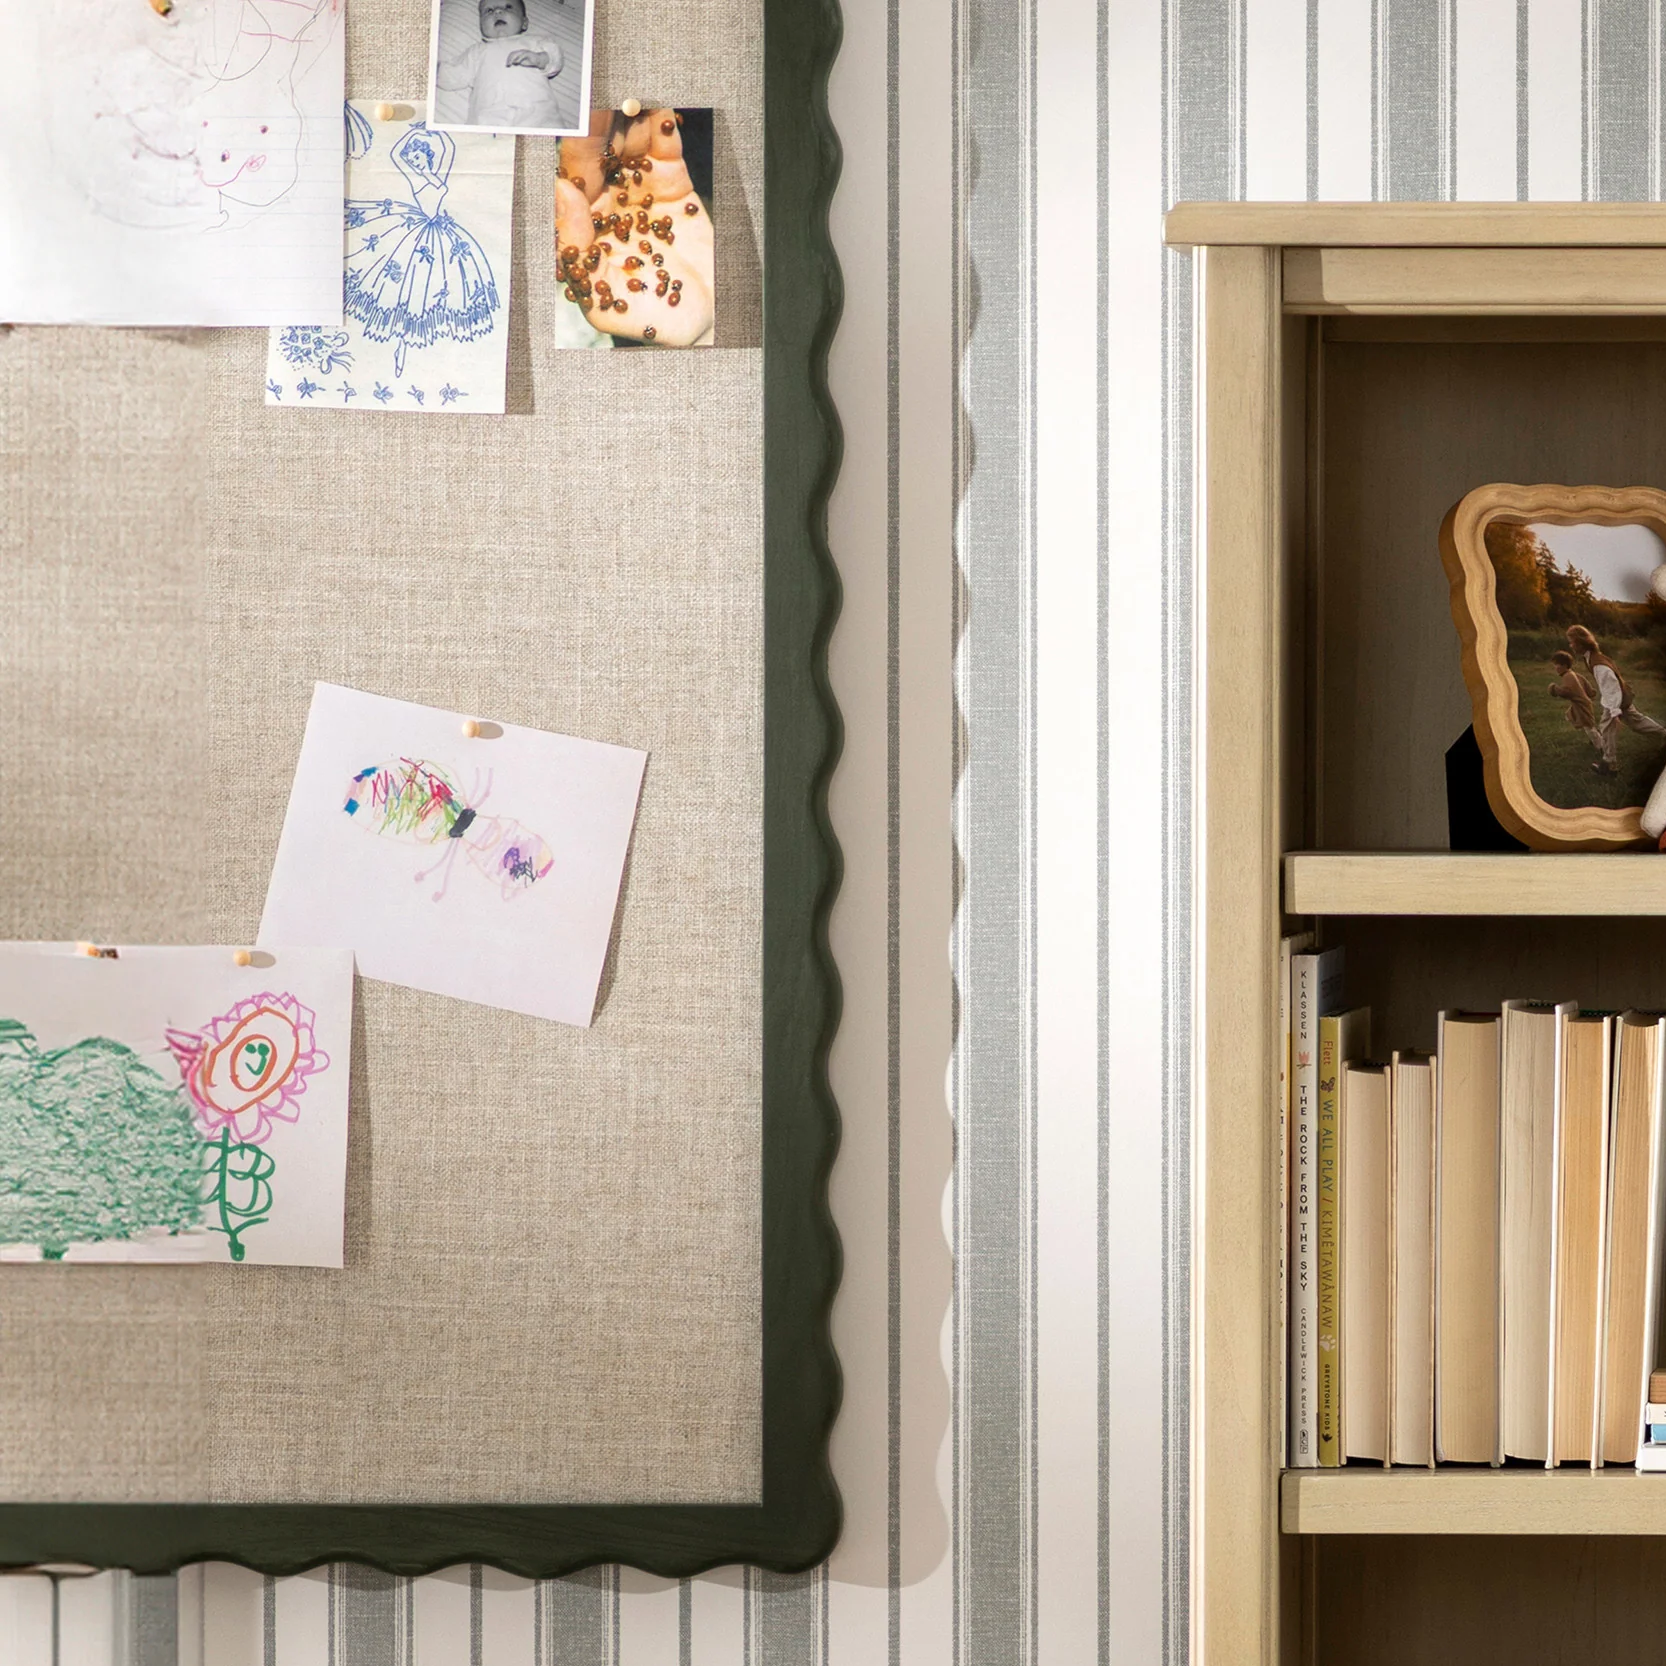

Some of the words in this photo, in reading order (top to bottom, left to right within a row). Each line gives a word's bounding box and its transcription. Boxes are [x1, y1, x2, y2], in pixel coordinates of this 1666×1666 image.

[1300, 970, 1308, 1040] KLASSEN
[1323, 1040, 1334, 1066] Flett
[1300, 1085, 1308, 1117] THE
[1322, 1100, 1334, 1122] WE
[1300, 1124, 1308, 1166] ROCK
[1322, 1128, 1333, 1152] ALL
[1322, 1160, 1333, 1192] PLAY
[1299, 1173, 1308, 1215] FROM
[1300, 1222, 1308, 1254] THE
[1300, 1261, 1308, 1292] SKY
[1300, 1307, 1308, 1382] CANDLEWICK
